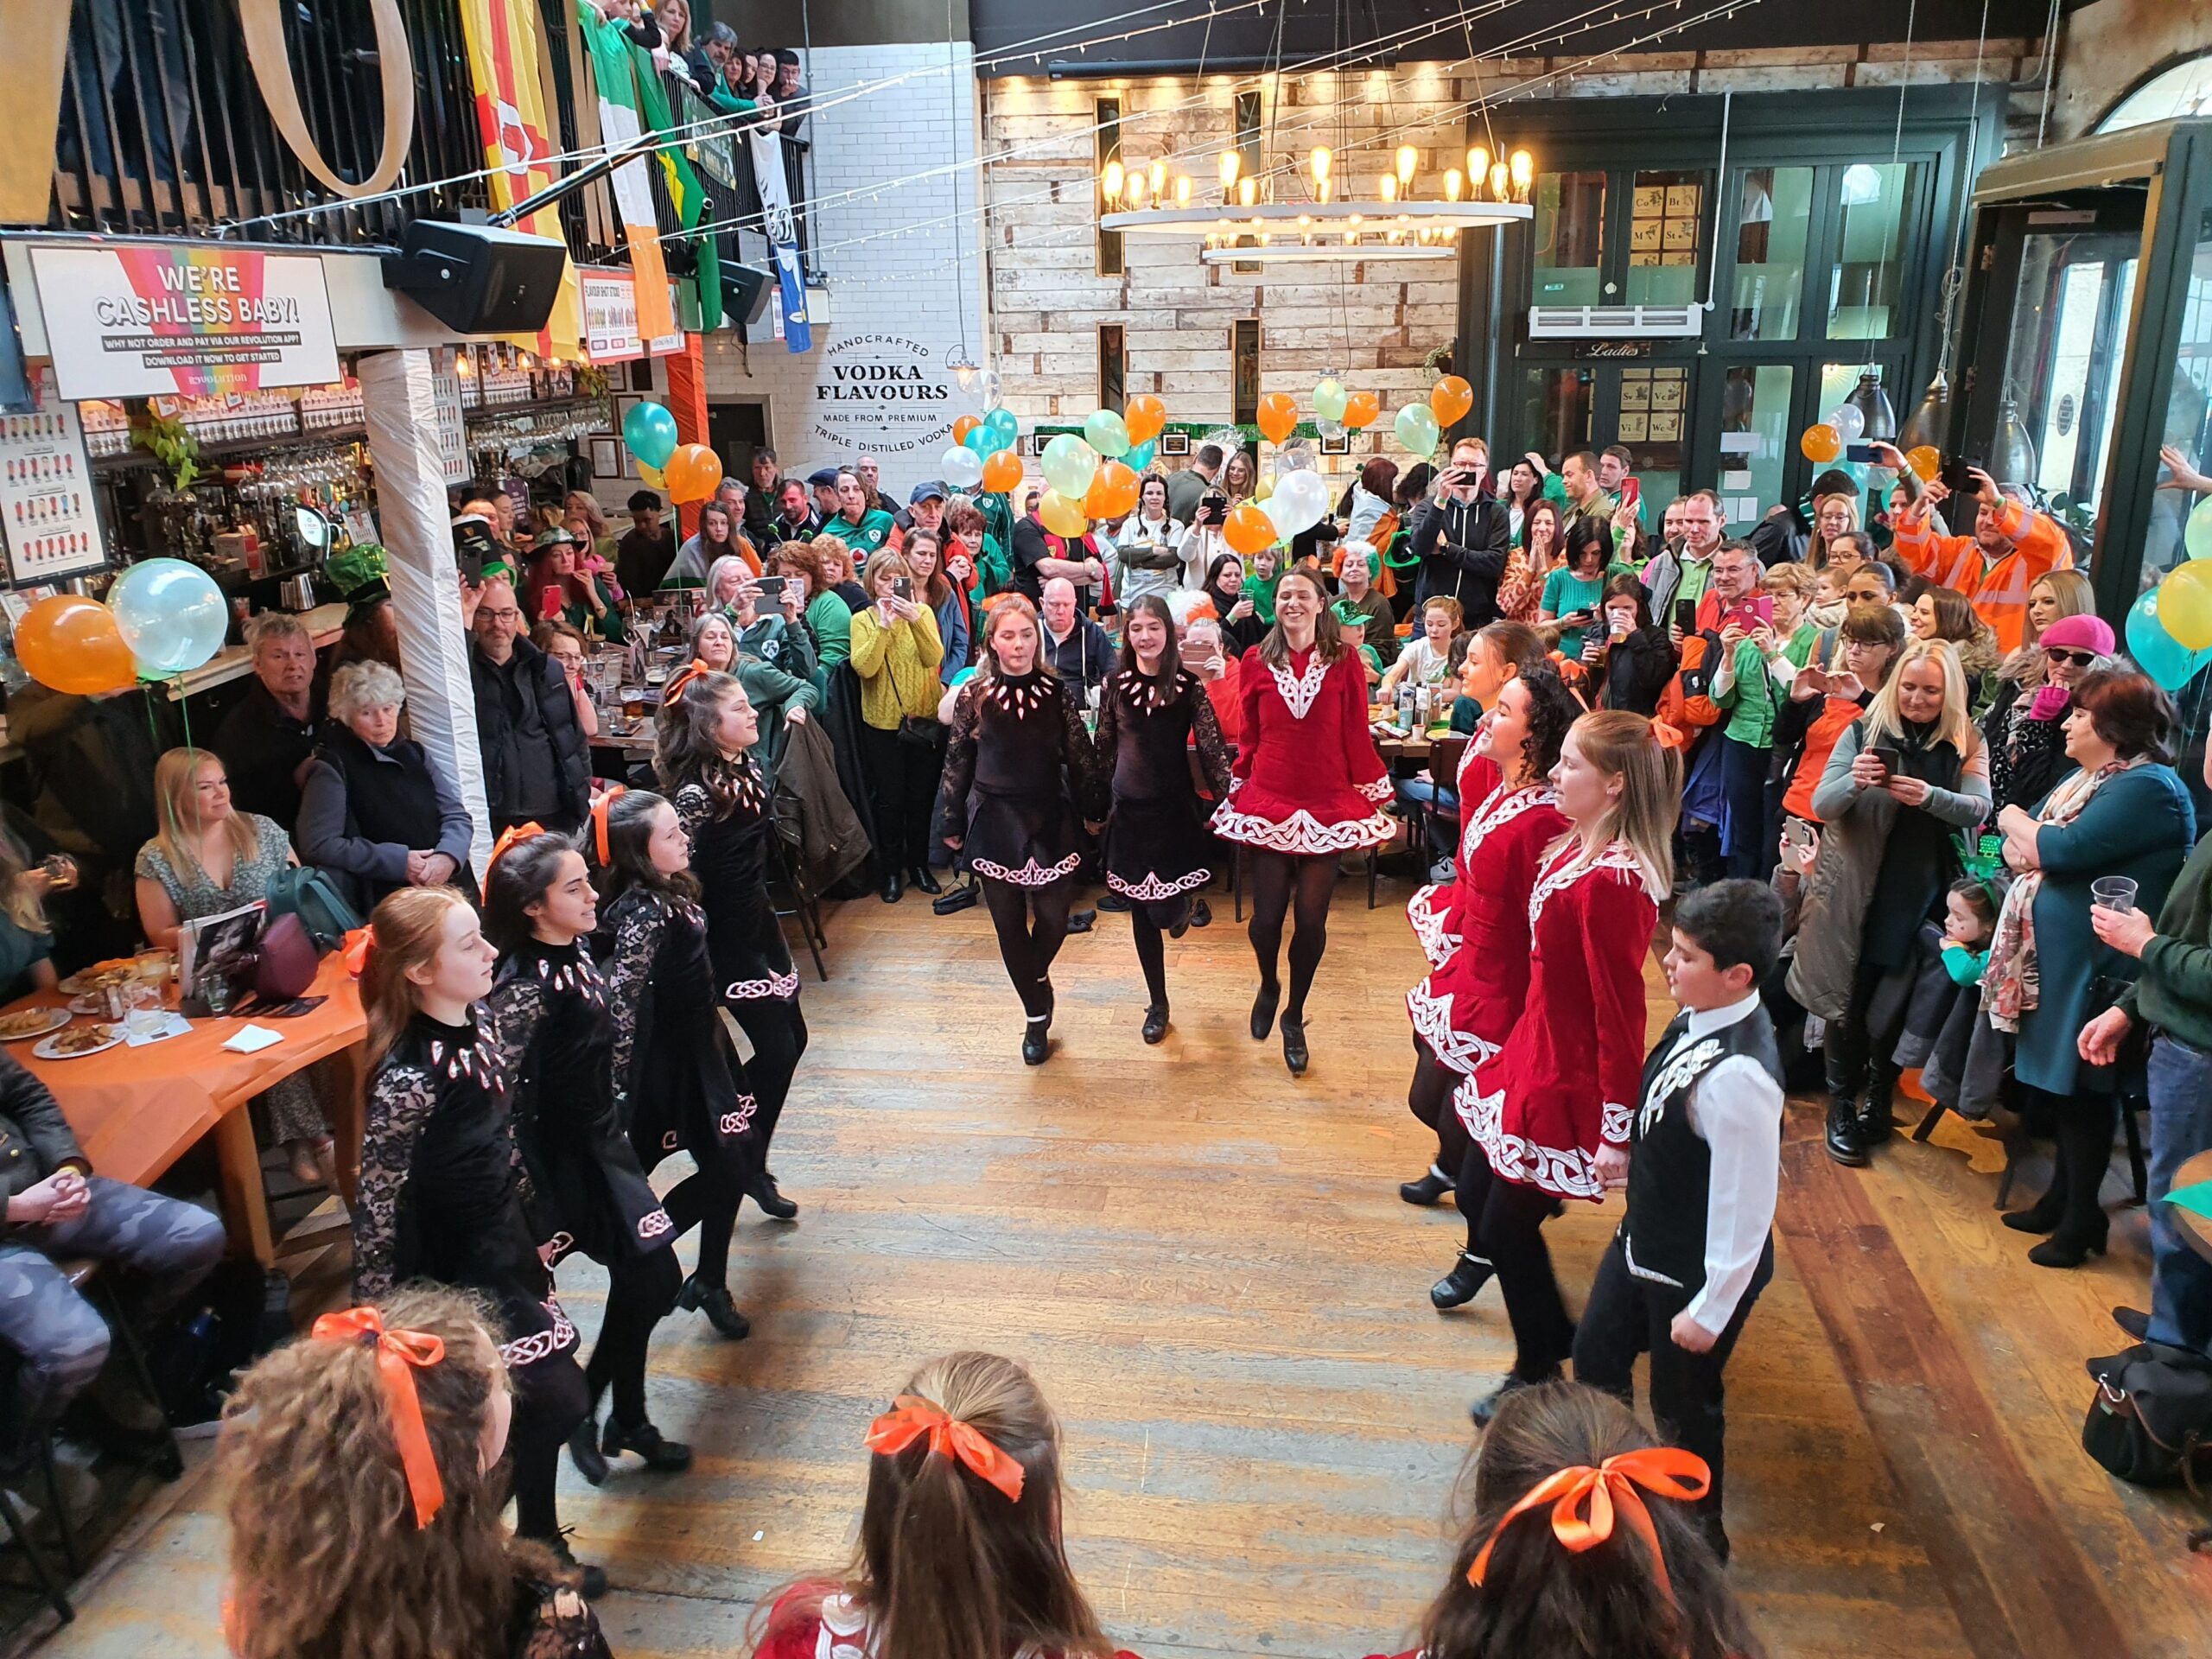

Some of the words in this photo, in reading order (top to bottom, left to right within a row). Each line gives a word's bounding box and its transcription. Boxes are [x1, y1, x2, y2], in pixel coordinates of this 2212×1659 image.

[93, 296, 233, 327] CASHLESS
[238, 297, 300, 324] BABY!
[105, 339, 126, 350] WHY
[128, 338, 147, 348] NOT
[148, 337, 175, 347] ORDER
[176, 336, 194, 346] AND
[194, 336, 210, 346] PAY
[211, 335, 225, 346] VIA
[225, 335, 240, 345] OUR
[241, 334, 283, 345] REVOLUTION
[283, 334, 300, 344] APP?
[827, 334, 929, 357] HANDCRAFTED
[1586, 343, 1638, 357] Ladies
[145, 355, 194, 366] DOWNLOAD
[195, 355, 203, 364] IT
[204, 354, 224, 364] NOW
[224, 354, 234, 363] TO
[236, 353, 250, 362] GET
[250, 352, 280, 362] STARTED
[832, 365, 924, 380] VODKA
[816, 385, 949, 400] FLAVOURS
[888, 414, 938, 423] PREMIUM
[815, 424, 853, 448] TRIPLE
[858, 441, 914, 453] DISTILLED
[918, 423, 954, 446] VODKA
